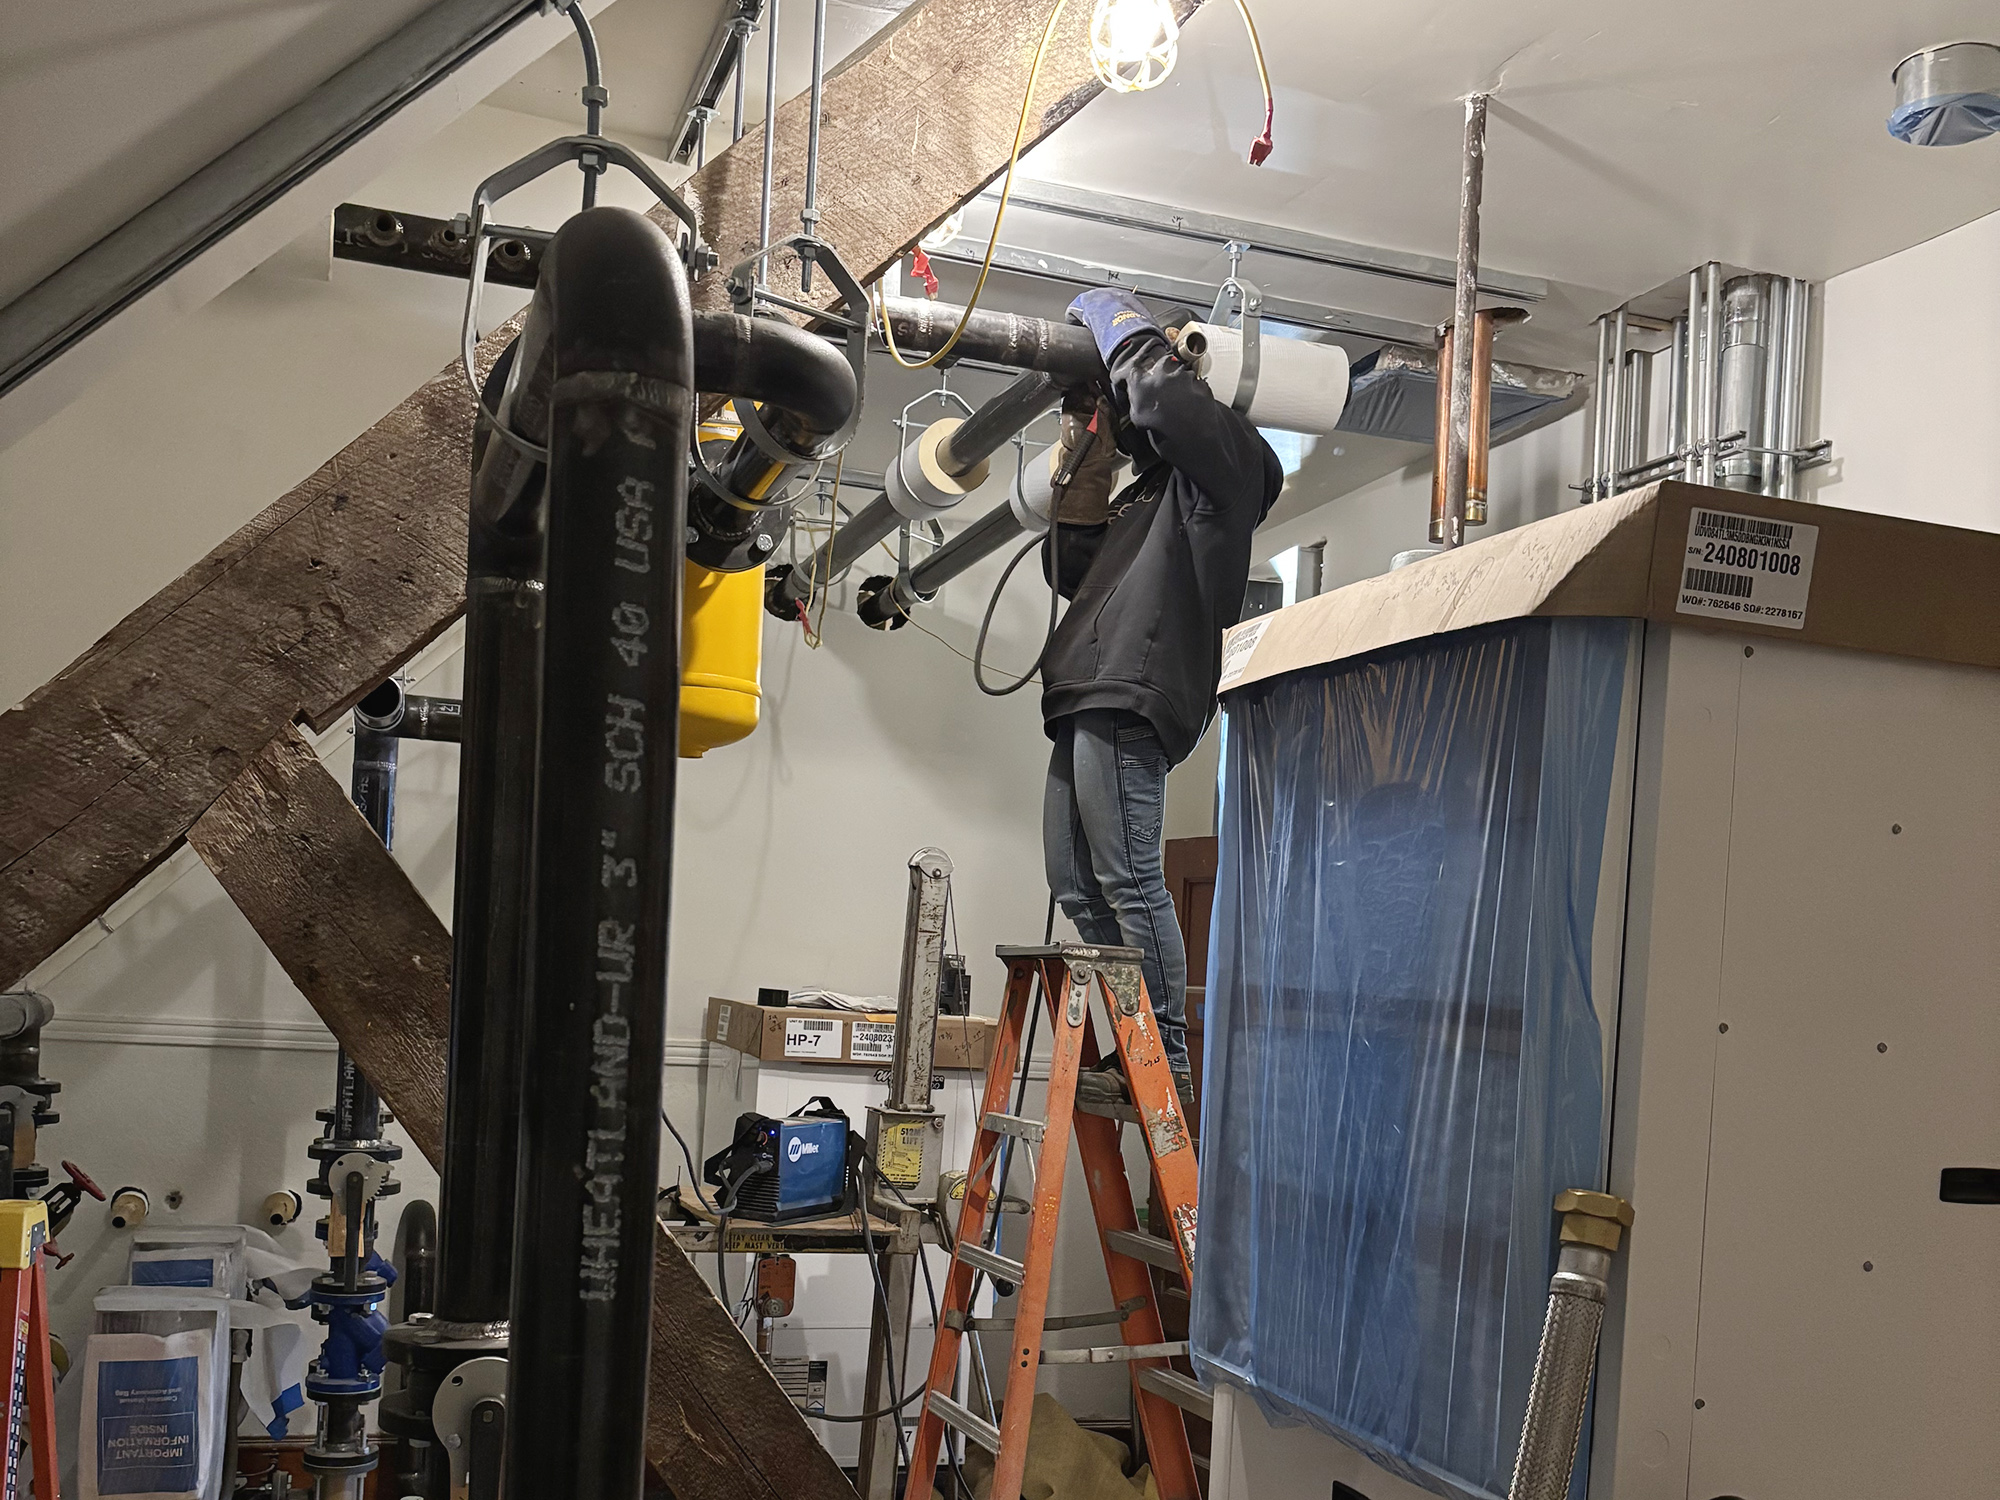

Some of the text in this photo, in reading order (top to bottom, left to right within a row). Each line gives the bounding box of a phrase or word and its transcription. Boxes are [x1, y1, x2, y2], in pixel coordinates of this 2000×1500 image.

[614, 475, 655, 574] USA
[1703, 542, 1801, 576] 240801008
[610, 601, 650, 668] 40
[603, 693, 646, 794] SCH
[786, 1033, 821, 1047] HP-7
[859, 1032, 896, 1043] 2408023
[902, 1136, 919, 1145] LIFT
[801, 1142, 820, 1155] Miller
[749, 1234, 770, 1242] CLEAR
[744, 1241, 763, 1249] MAST
[128, 1424, 168, 1435] INSIDE
[107, 1435, 189, 1448] INFORMATION
[115, 1447, 183, 1460] IMPORTANT
